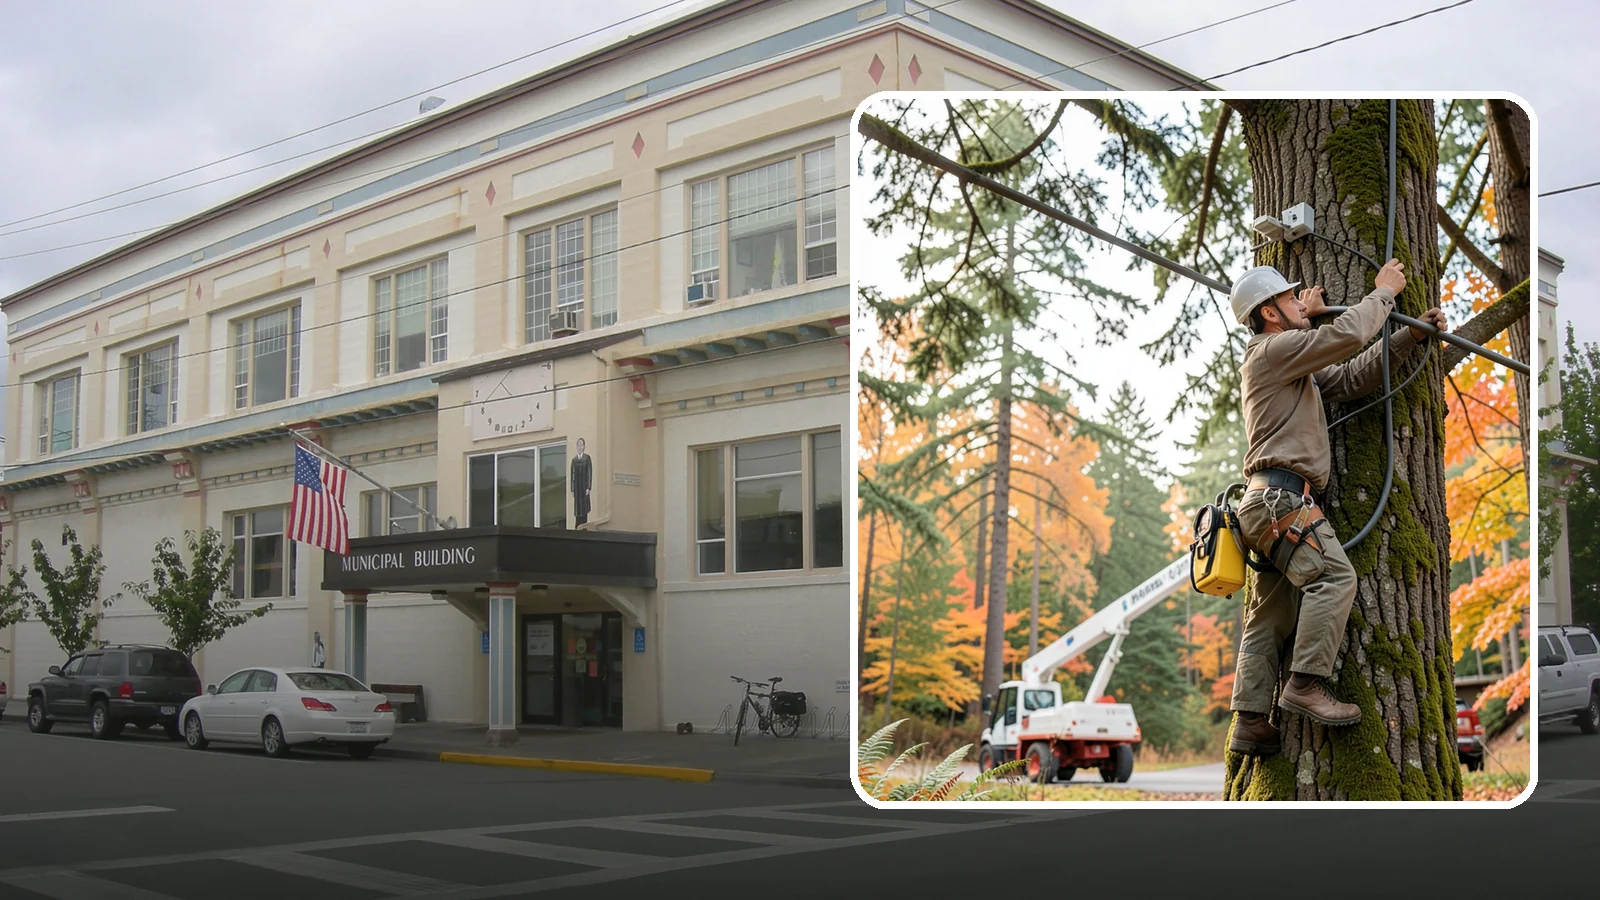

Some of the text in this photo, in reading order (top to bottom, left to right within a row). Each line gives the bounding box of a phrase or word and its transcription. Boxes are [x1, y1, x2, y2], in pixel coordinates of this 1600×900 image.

[480, 406, 485, 415] 8
[487, 417, 492, 426] 9
[528, 413, 533, 422] 3
[494, 423, 500, 432] 10
[521, 420, 526, 428] 2
[507, 425, 513, 433] 12
[342, 546, 475, 572] MUNICIPAL BUILDING
